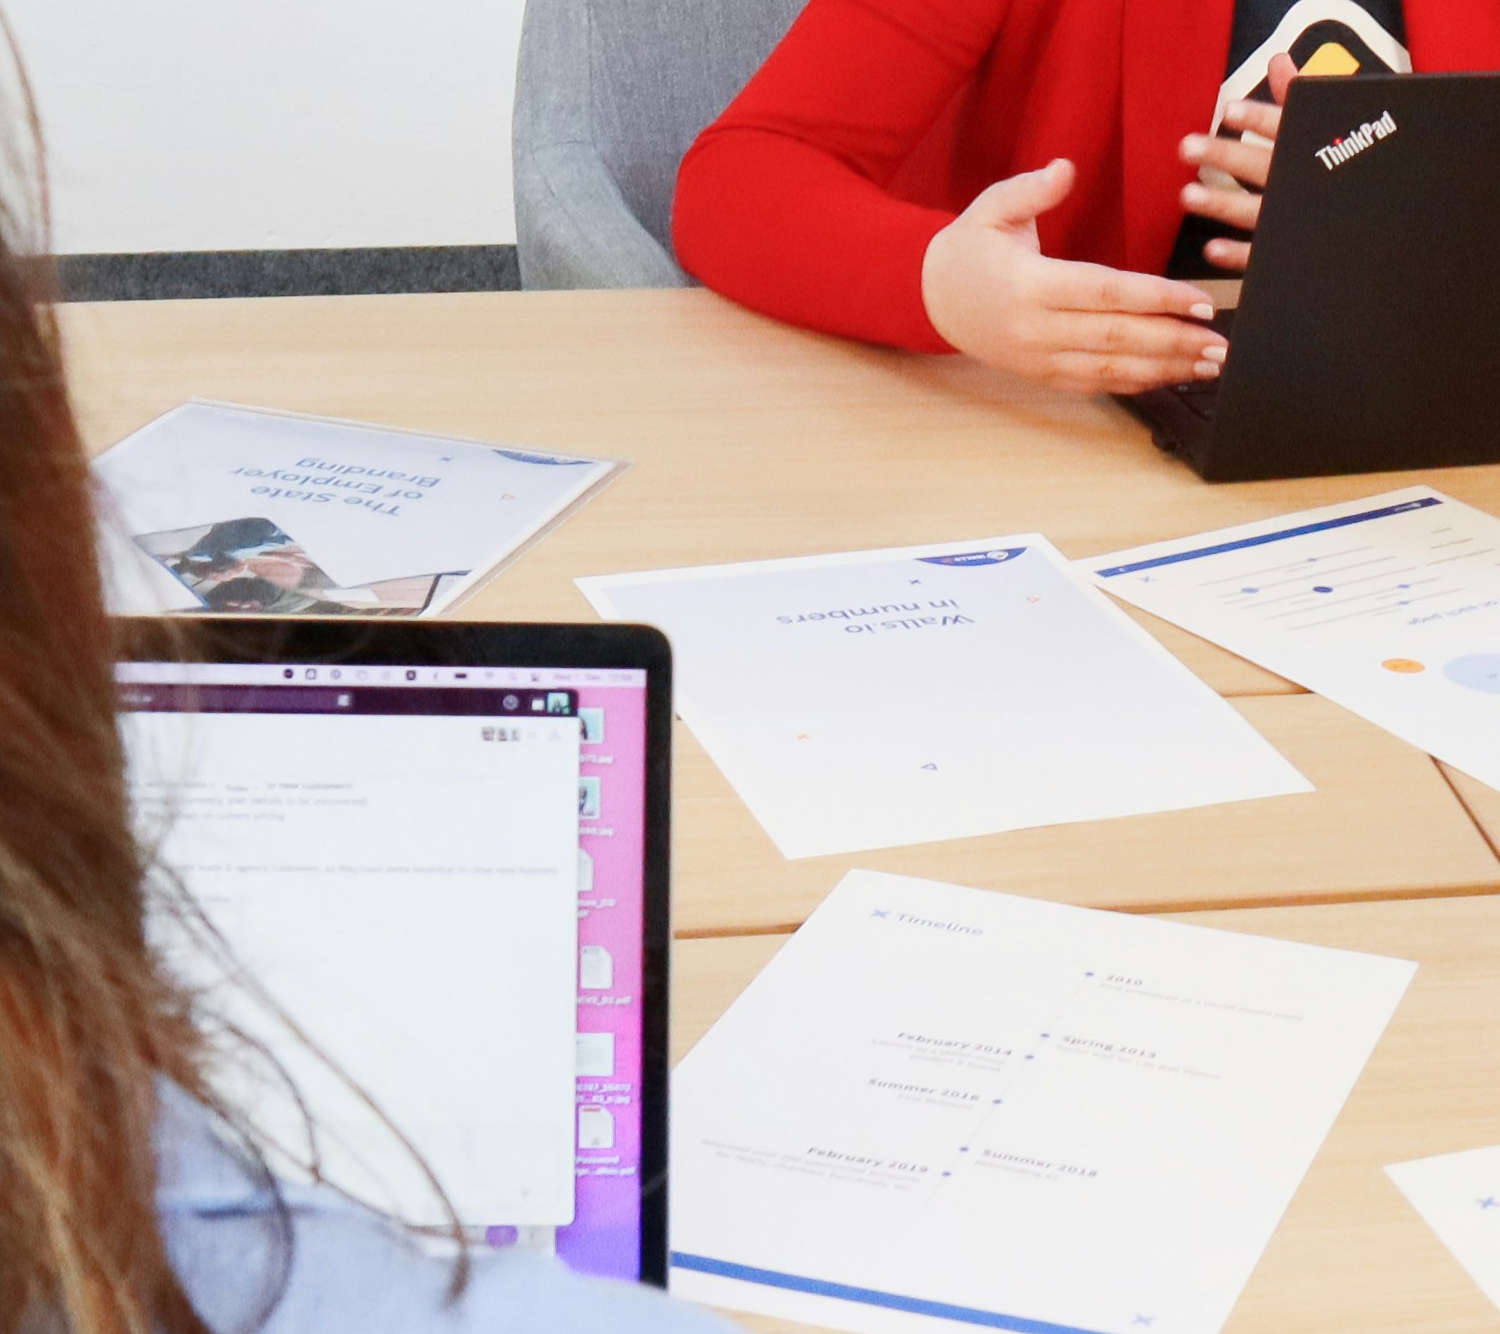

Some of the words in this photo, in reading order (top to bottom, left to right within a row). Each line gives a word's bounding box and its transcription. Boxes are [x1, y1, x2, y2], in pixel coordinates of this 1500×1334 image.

[1315, 110, 1397, 171] ThinkPad
[228, 467, 384, 495] Employer
[296, 458, 441, 488] Branding
[250, 486, 337, 503] State
[386, 490, 423, 502] of
[343, 496, 401, 518] The
[776, 602, 920, 626] numbers
[929, 599, 959, 610] in
[898, 913, 984, 936] Timeline
[897, 1031, 970, 1051] February
[1063, 1034, 1113, 1053] Spring
[868, 1077, 936, 1095] Summer
[806, 1146, 880, 1168] February
[981, 1148, 1052, 1169] Summer
